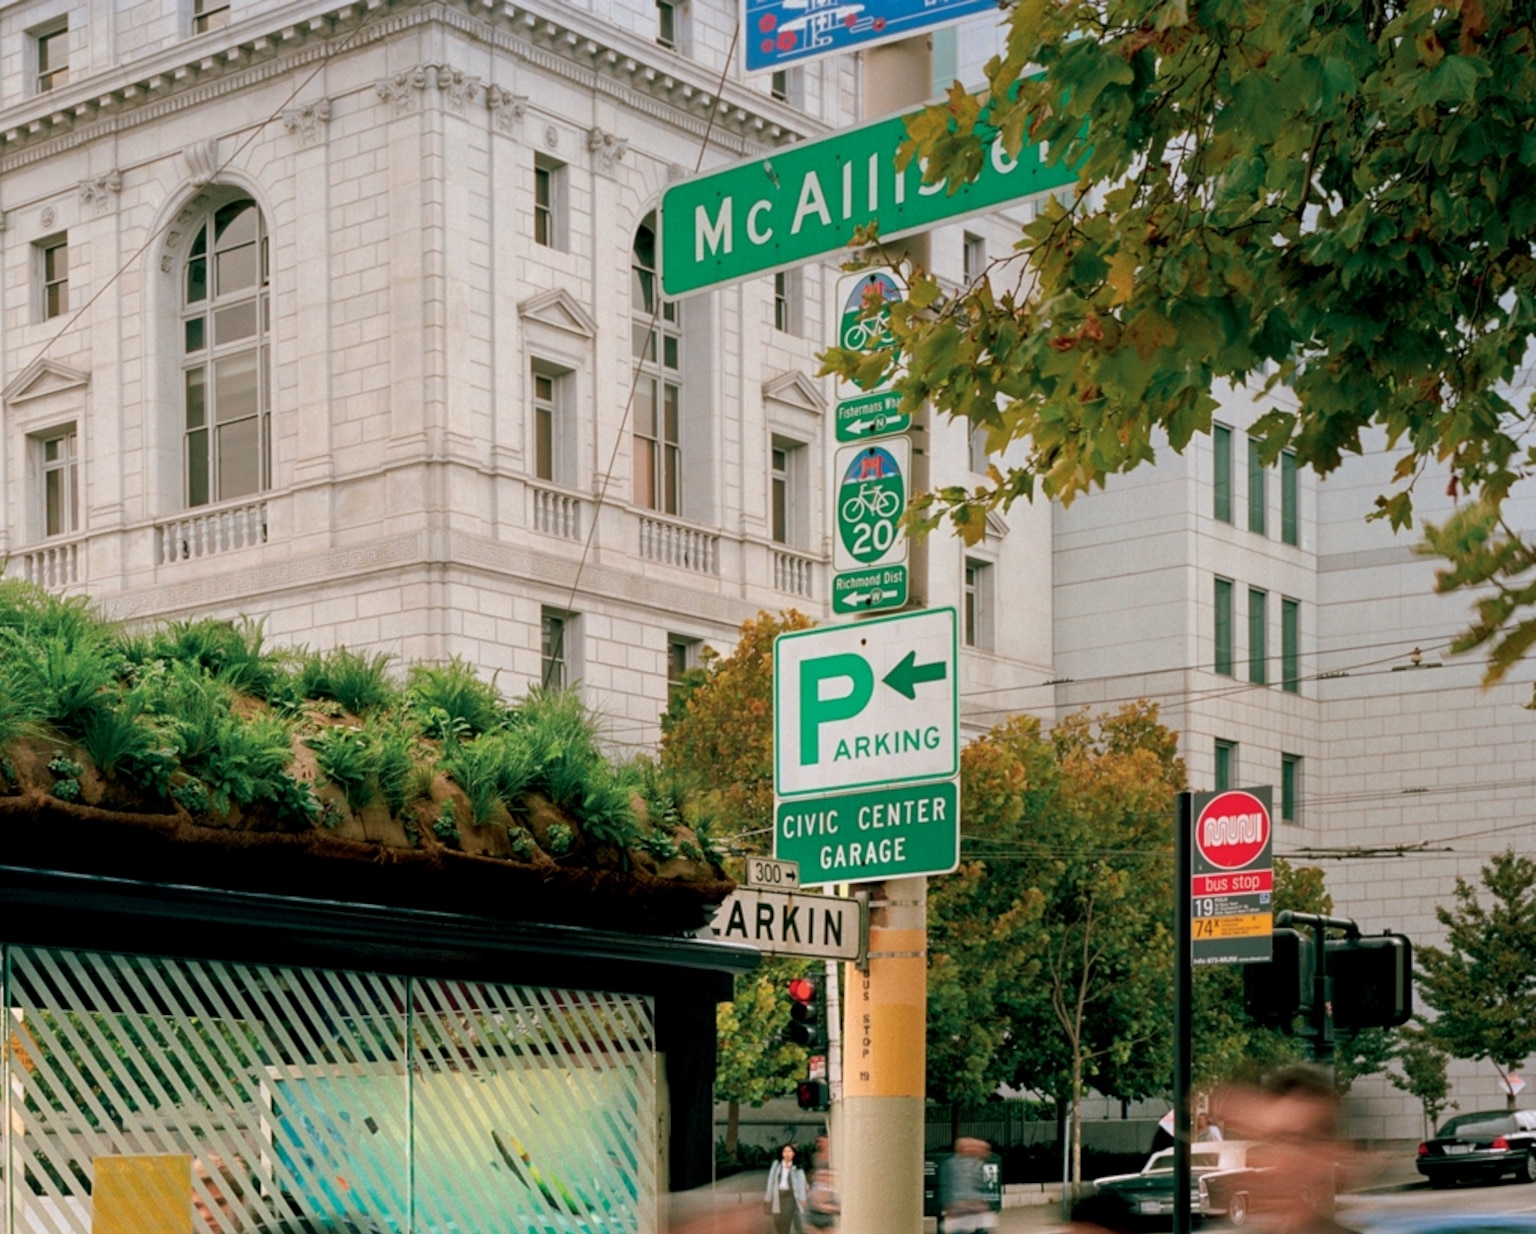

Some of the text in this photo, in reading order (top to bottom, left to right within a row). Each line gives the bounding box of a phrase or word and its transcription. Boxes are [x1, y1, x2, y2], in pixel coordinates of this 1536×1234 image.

[838, 401, 883, 420] Fishermans
[852, 519, 894, 555] 20
[836, 570, 903, 590] Richmond Dist
[782, 797, 946, 840] CIVIC CENTER
[820, 838, 906, 869] GARAGE
[755, 862, 782, 884] 300
[1205, 874, 1261, 893] bus stop
[1194, 898, 1214, 917] 19
[711, 900, 843, 947] ARKIN
[862, 1014, 872, 1058] STOP
[859, 1072, 870, 1081] 19
